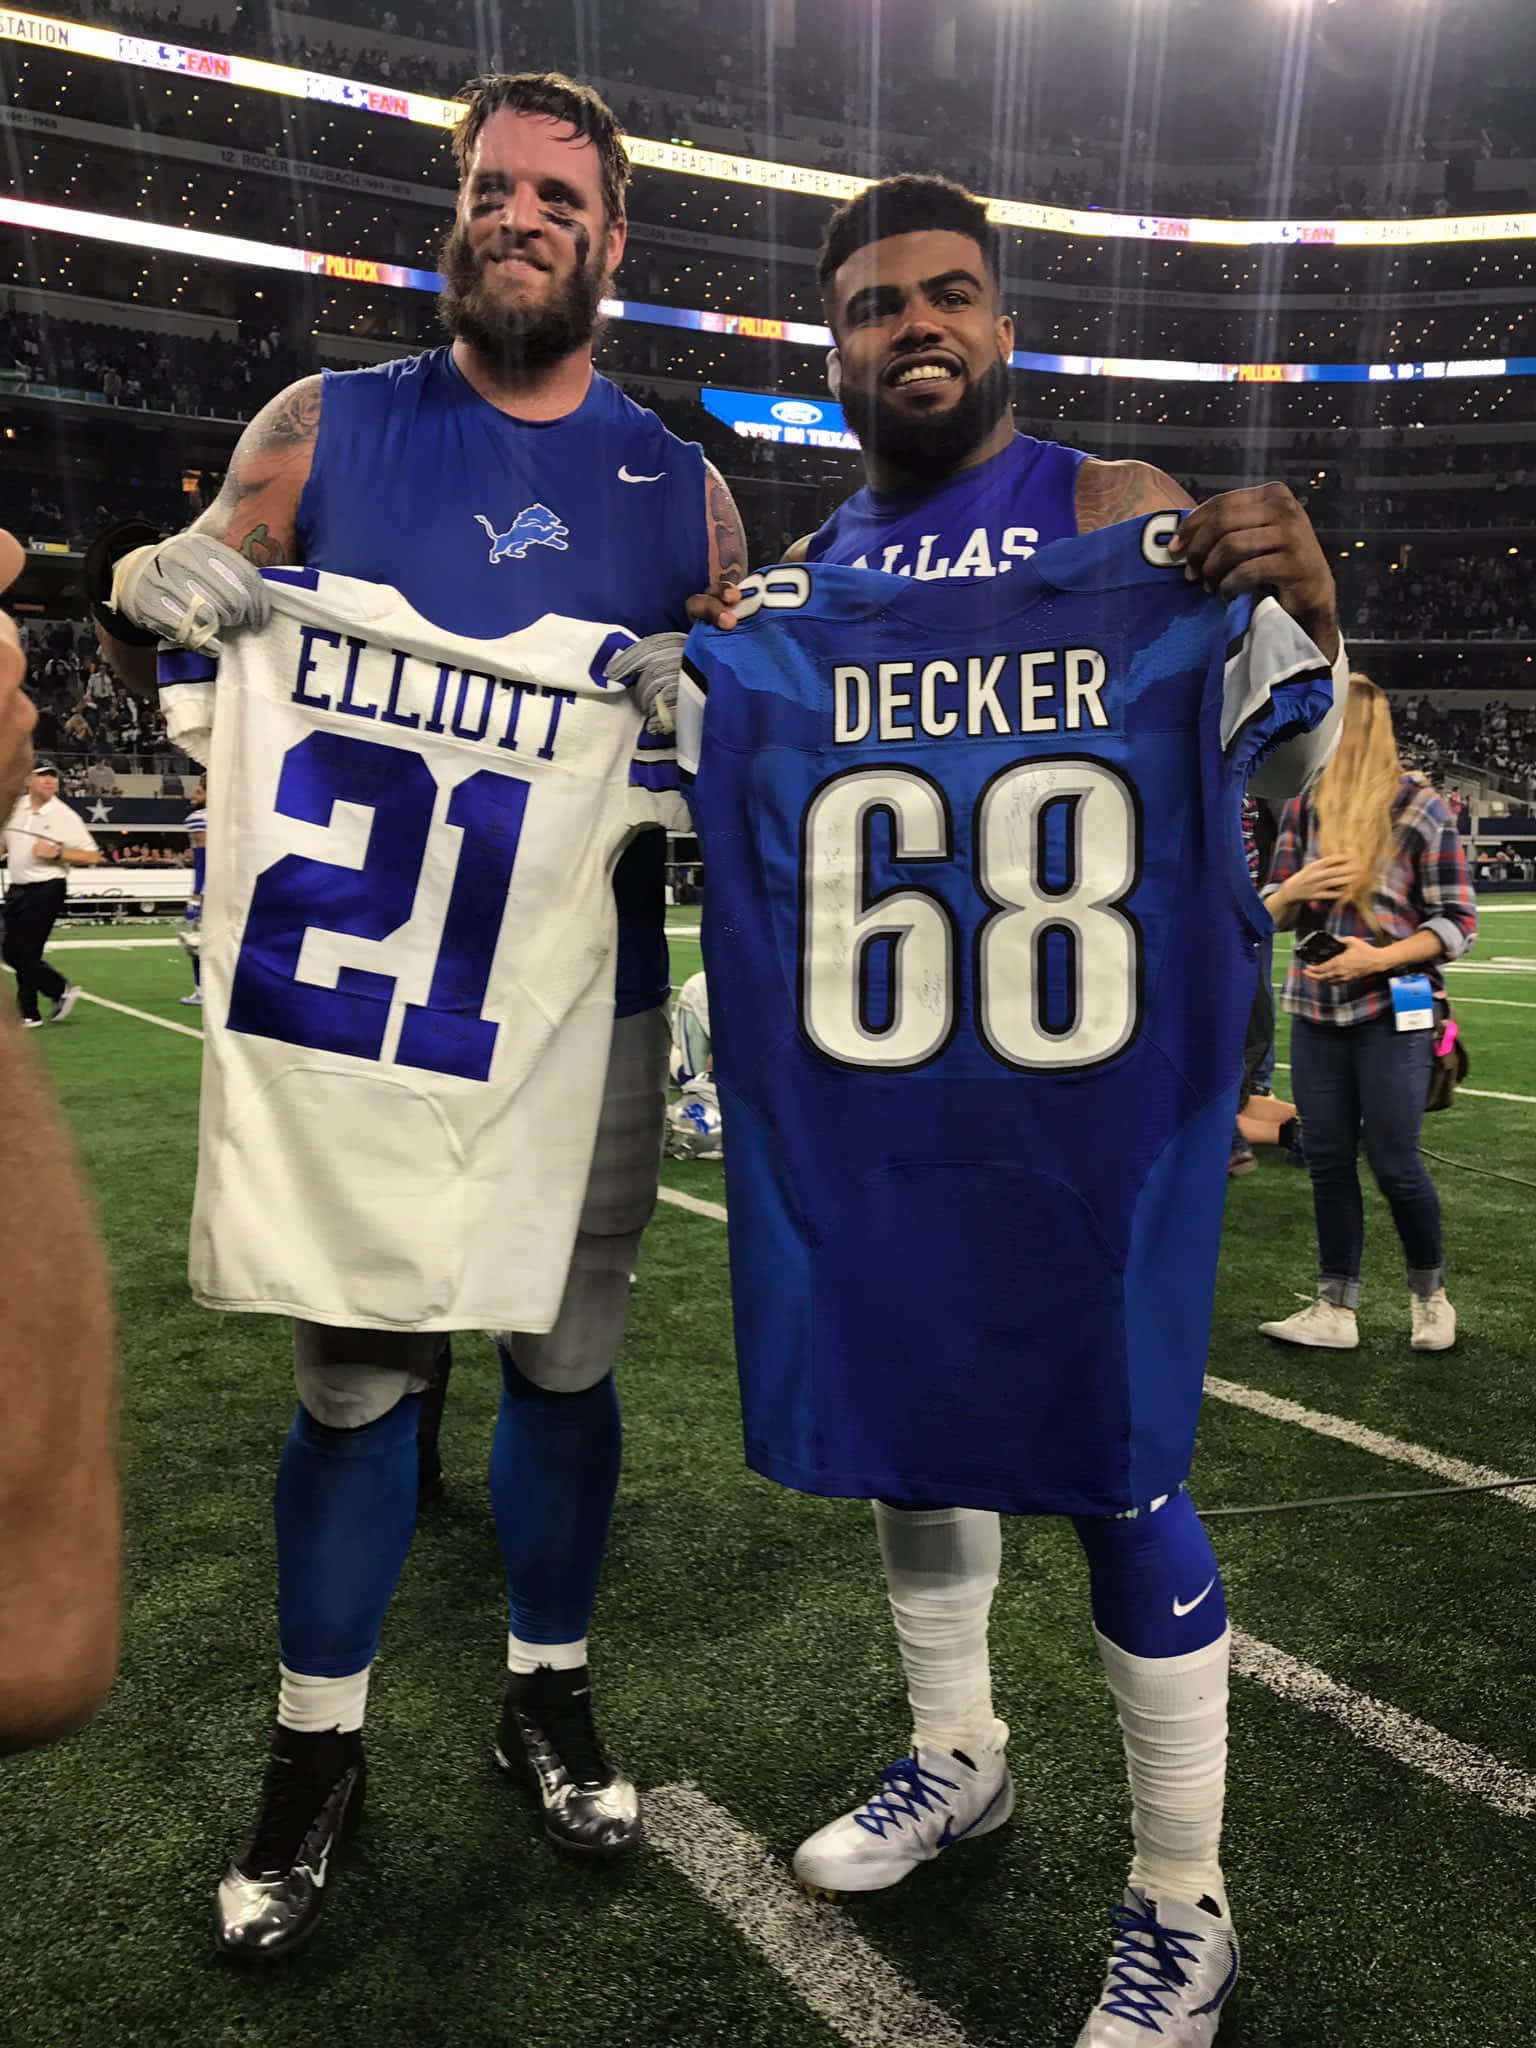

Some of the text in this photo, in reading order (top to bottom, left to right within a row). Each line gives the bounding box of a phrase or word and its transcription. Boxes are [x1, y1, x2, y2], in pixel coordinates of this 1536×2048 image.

[186, 53, 230, 77] FAN
[368, 93, 409, 116] FAN
[242, 155, 289, 174] ROGER
[1158, 223, 1190, 238] FAN
[1303, 229, 1336, 243] FAN
[326, 256, 379, 282] POLLOCK
[291, 626, 576, 760] ELLIOTT
[833, 648, 1110, 744] DECKER
[226, 730, 531, 1082] 21
[797, 752, 1144, 1075] 68
